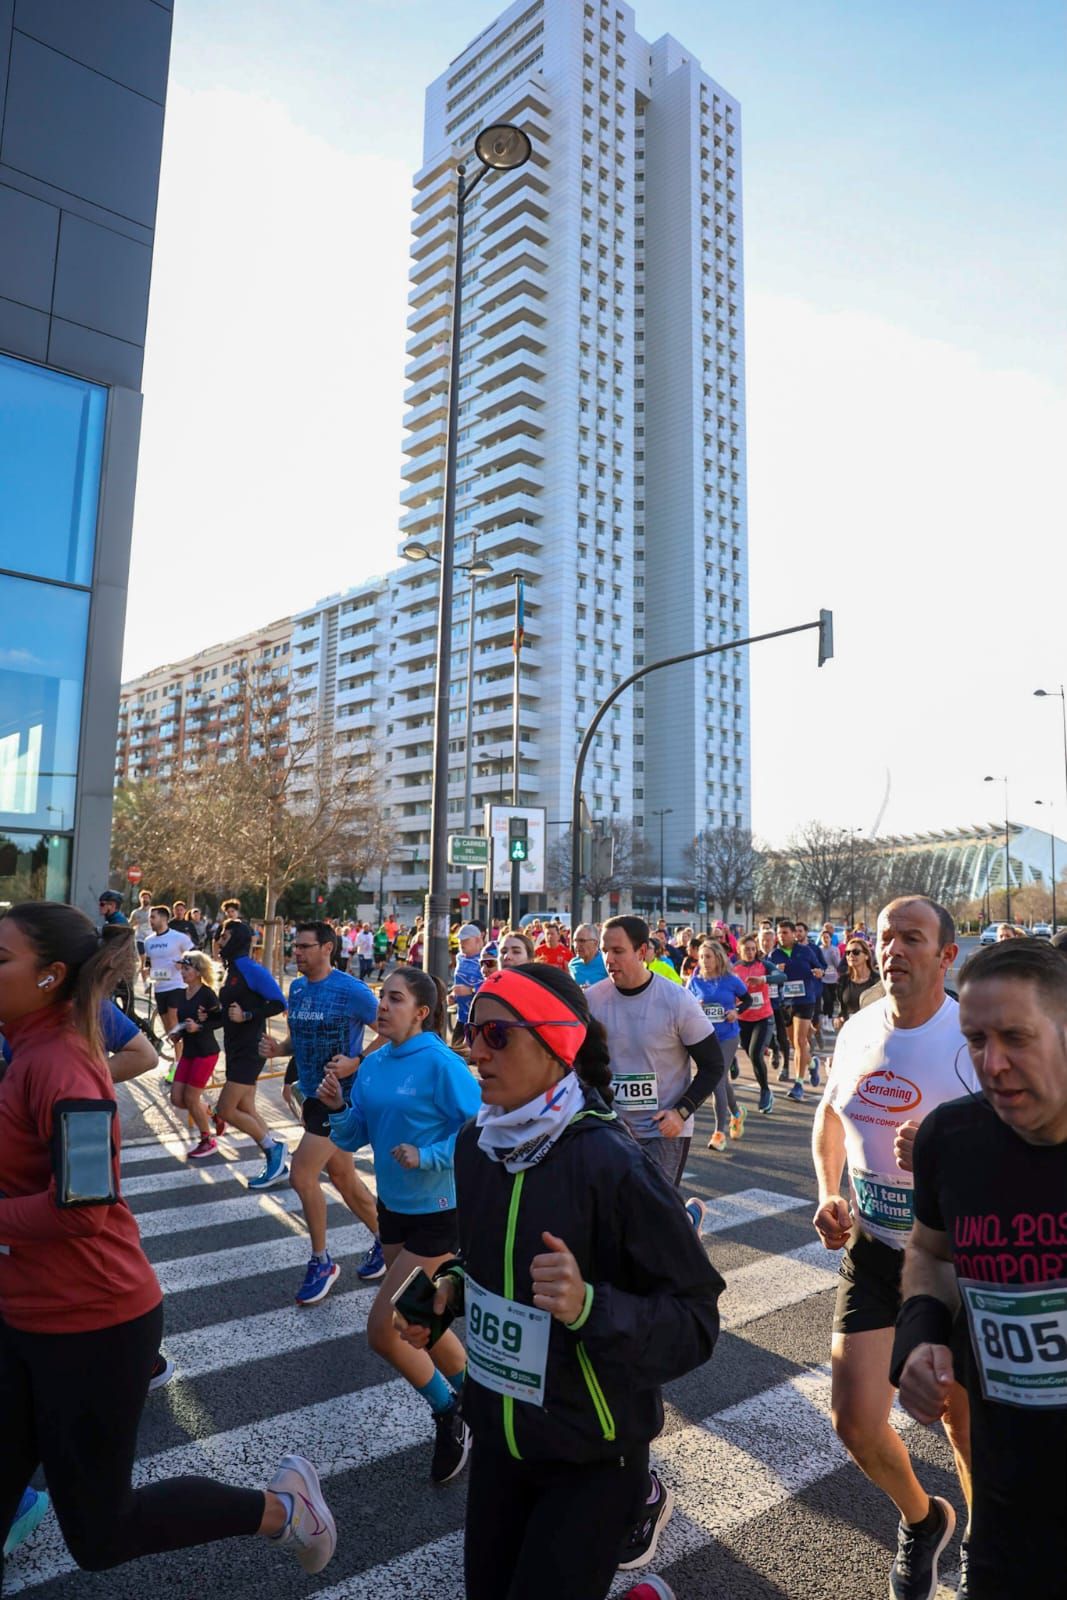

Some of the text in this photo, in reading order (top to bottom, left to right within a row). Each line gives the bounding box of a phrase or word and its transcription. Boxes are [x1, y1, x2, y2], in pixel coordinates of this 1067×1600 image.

[612, 1082, 652, 1097] 7186
[863, 1080, 912, 1103] Serraning
[881, 1188, 907, 1204] teu
[872, 1200, 911, 1218] Ritme
[470, 1302, 522, 1353] 969
[981, 1318, 1067, 1369] 805
